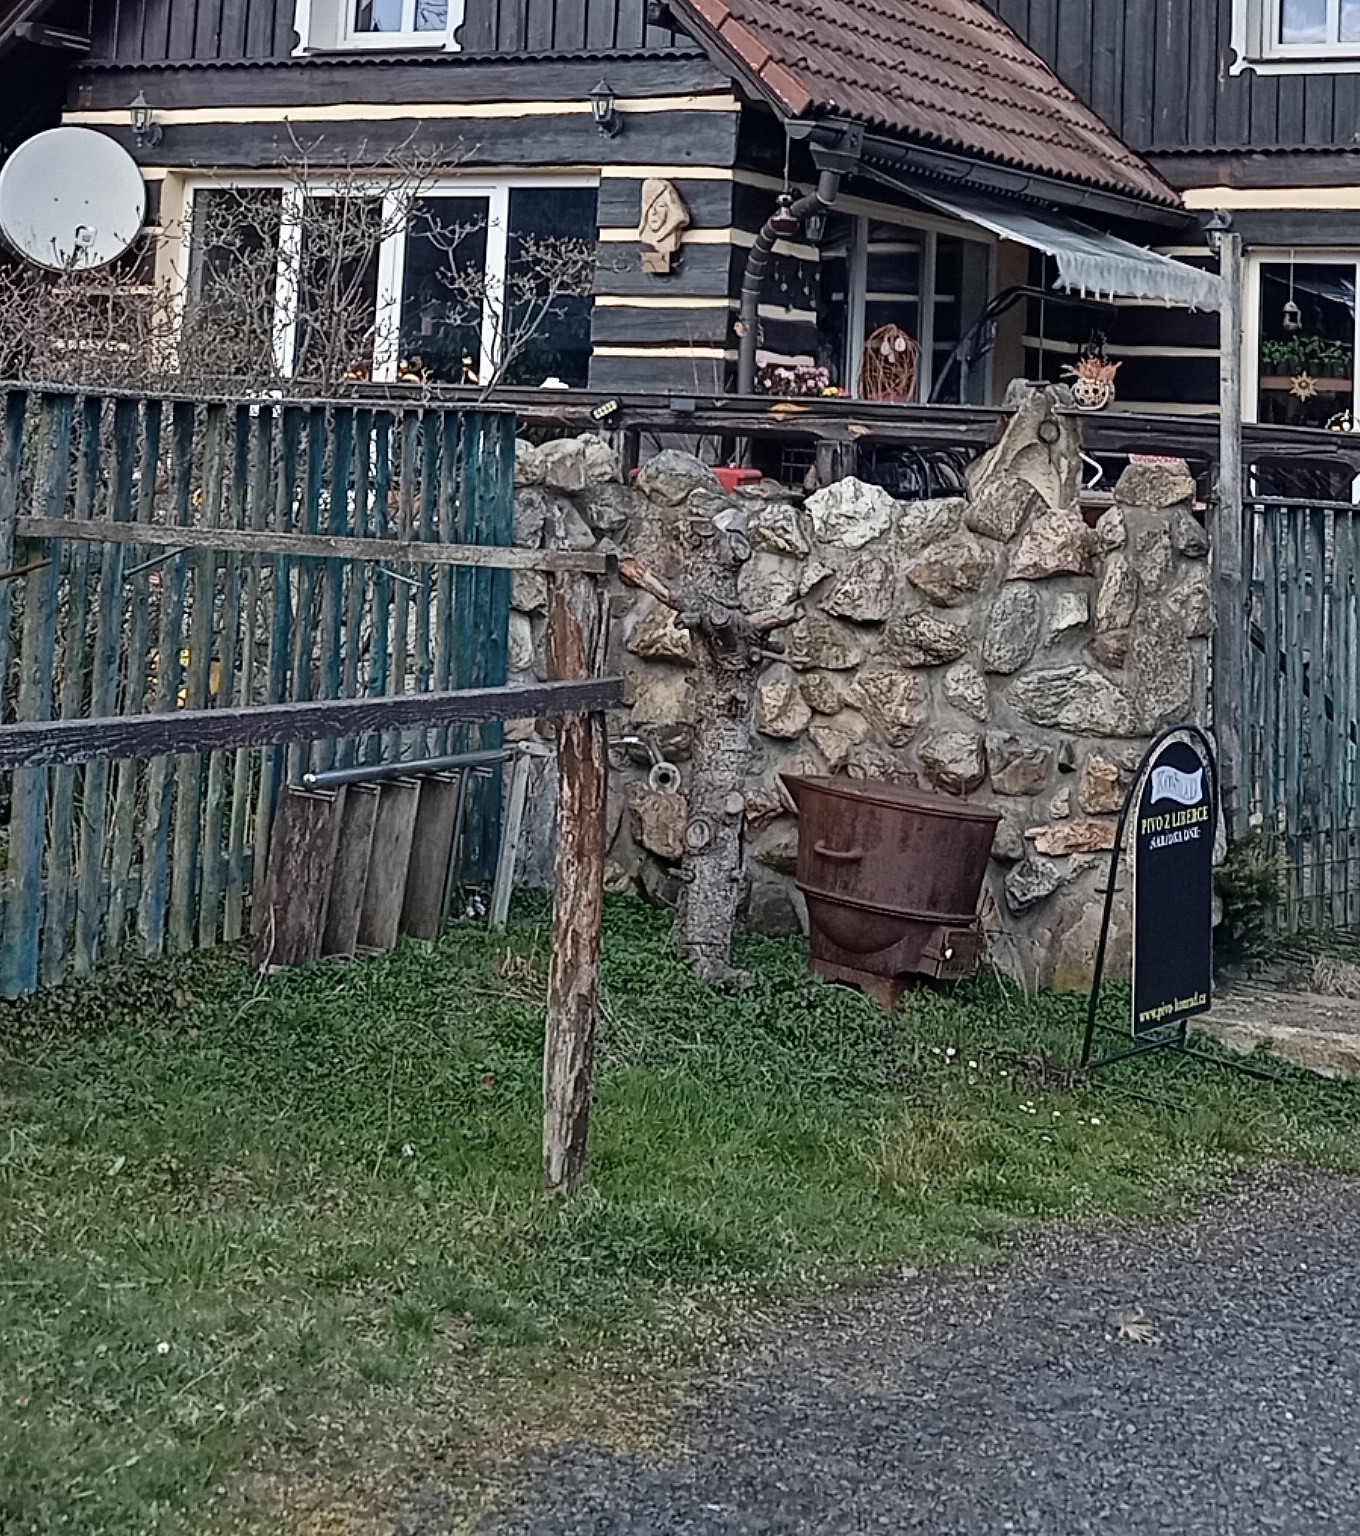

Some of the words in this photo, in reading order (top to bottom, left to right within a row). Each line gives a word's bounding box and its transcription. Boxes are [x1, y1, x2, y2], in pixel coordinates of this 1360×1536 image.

[1141, 815, 1163, 836] PIVO
[1164, 813, 1171, 829] Z
[1172, 805, 1209, 828] LIBERCE
